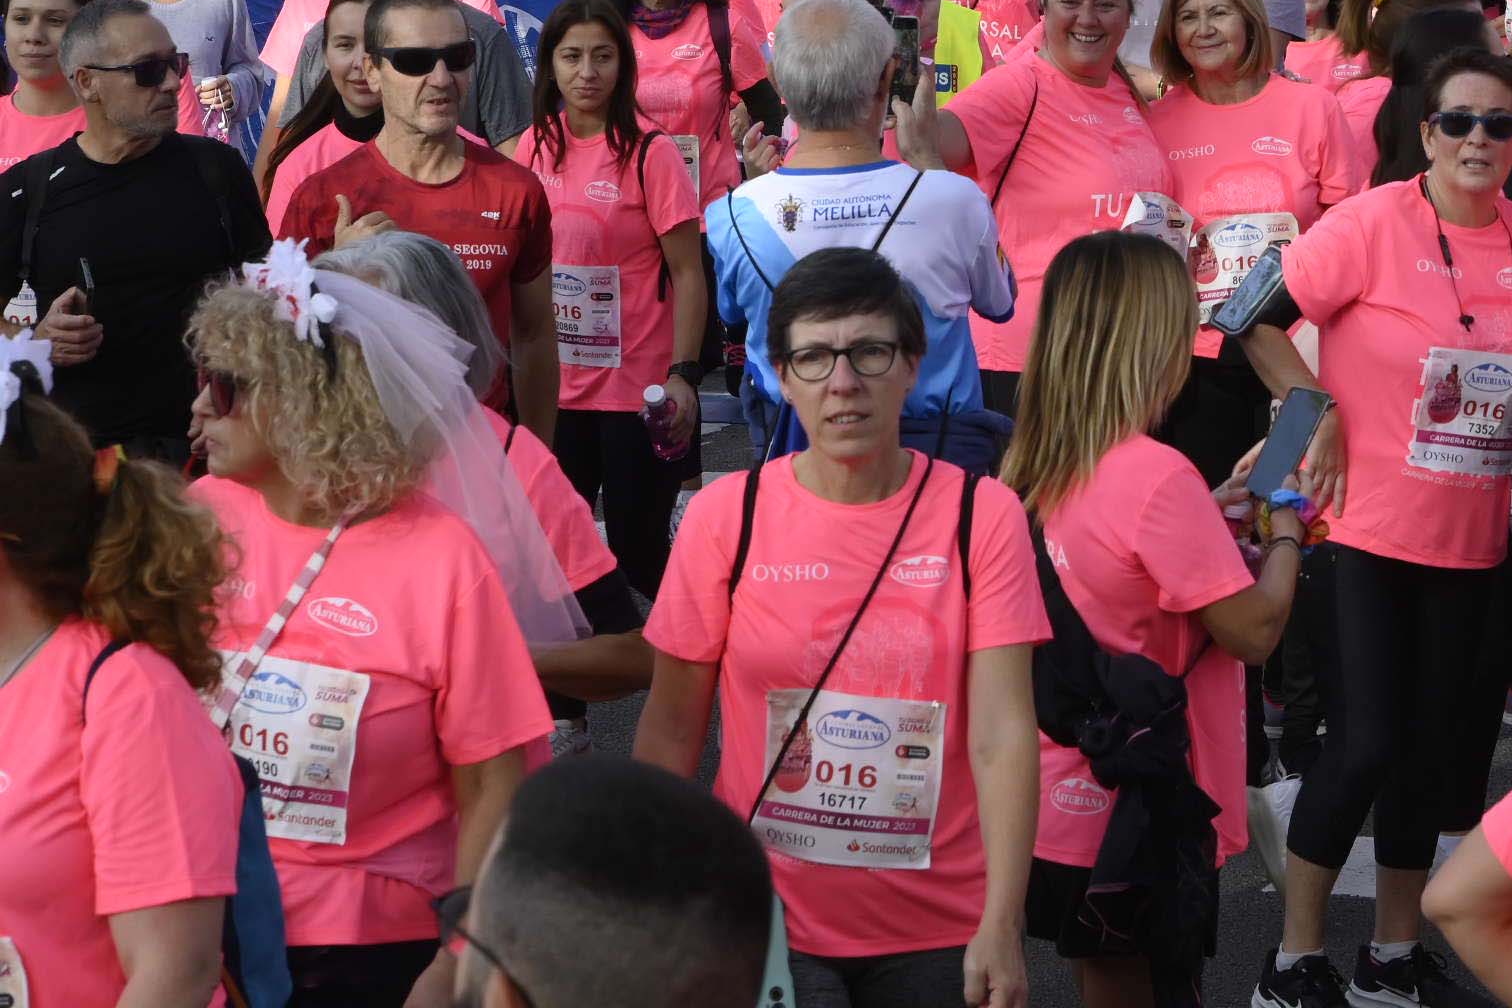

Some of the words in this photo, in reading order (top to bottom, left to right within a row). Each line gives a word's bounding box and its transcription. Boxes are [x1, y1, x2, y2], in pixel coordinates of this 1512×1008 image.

[1168, 143, 1216, 161] OYSHO
[813, 202, 892, 222] MELILLA
[1091, 192, 1123, 218] TU
[1217, 231, 1261, 246] ASTURIANA
[454, 243, 508, 256] SEGOVIA
[466, 259, 492, 270] 2019
[1221, 255, 1259, 270] 016
[1417, 259, 1463, 280] OYHO
[1468, 371, 1512, 387] ASTURIANA
[1463, 399, 1507, 420] 016
[1468, 422, 1495, 436] 7352
[1429, 434, 1466, 446] CARRERA
[1467, 438, 1477, 448] DE
[1477, 439, 1487, 449] LA
[1423, 450, 1464, 465] OYSHO
[752, 562, 829, 583] OYSHO
[312, 604, 372, 634] ASTURIANA
[314, 691, 350, 705] SUMA
[239, 723, 289, 756] 016
[819, 719, 890, 744] ASTURIANA
[815, 759, 878, 789] 016
[271, 784, 304, 800] MUJER
[307, 791, 333, 803] 2023
[818, 791, 868, 810] 16717
[277, 810, 337, 829] Santander
[771, 806, 818, 824] CARRERA
[819, 814, 834, 827] DE
[836, 815, 851, 828] LA
[853, 817, 890, 831] MUJER
[766, 827, 816, 849] OYSHO
